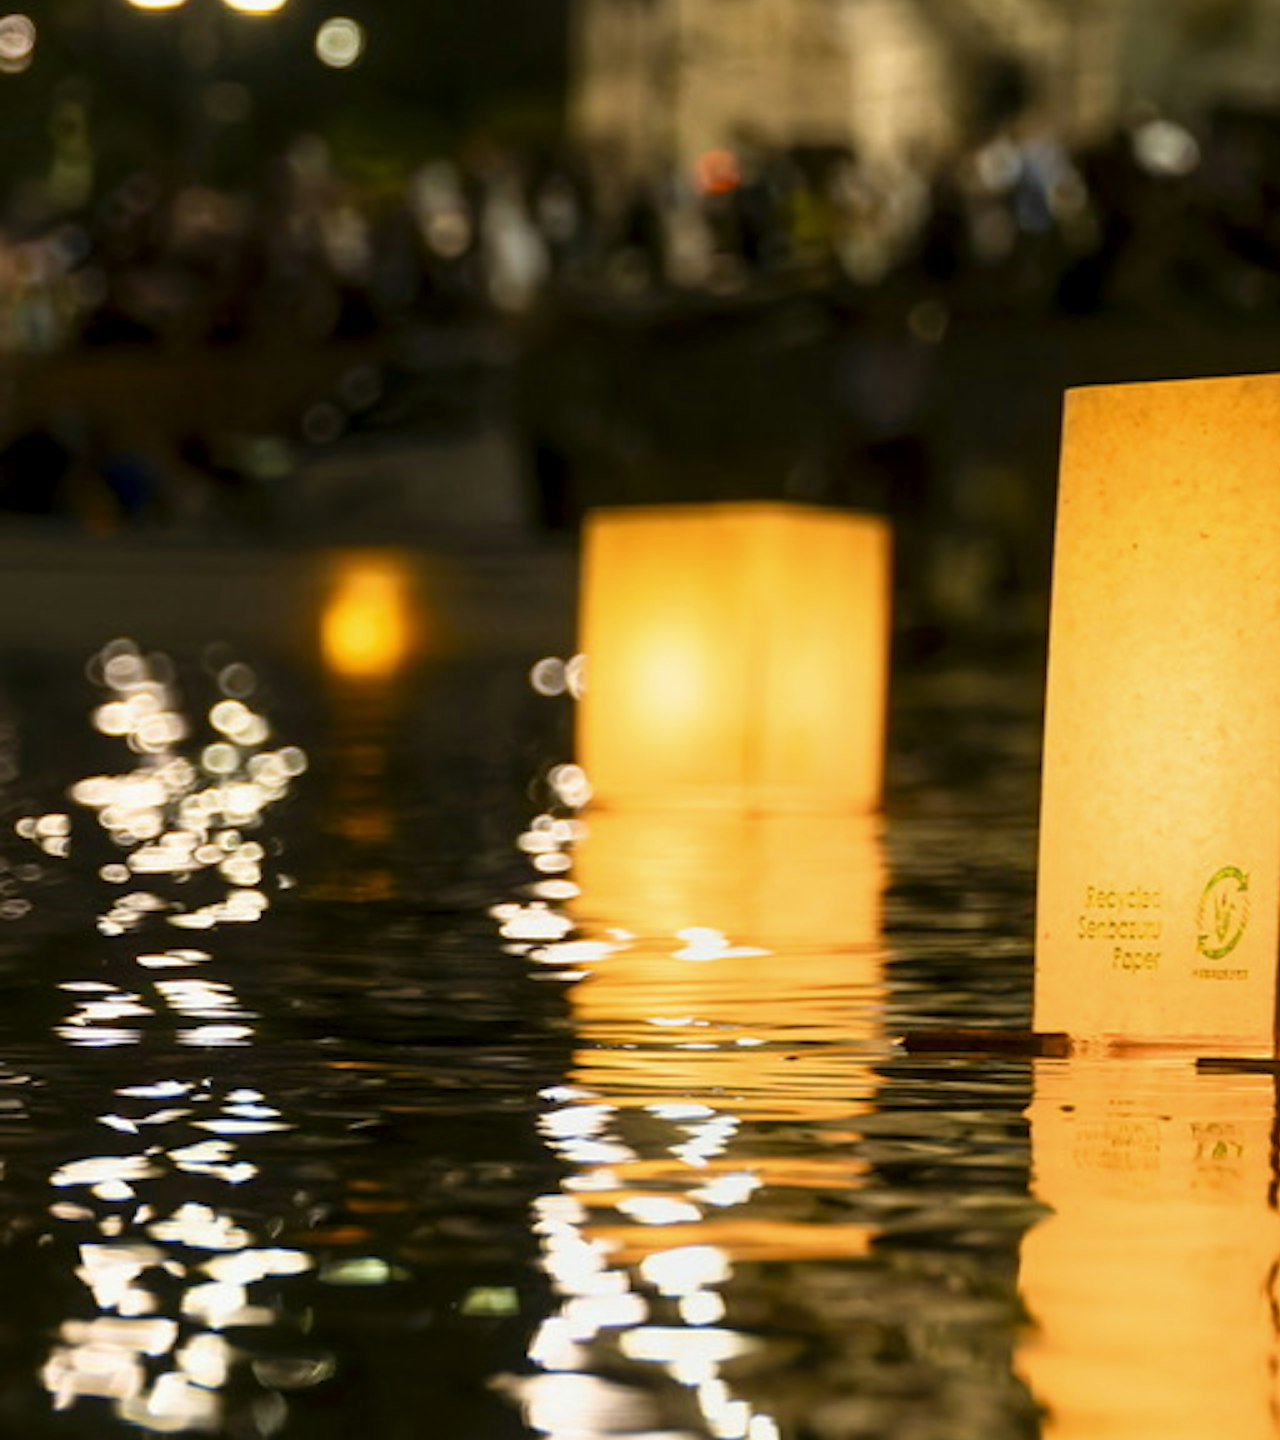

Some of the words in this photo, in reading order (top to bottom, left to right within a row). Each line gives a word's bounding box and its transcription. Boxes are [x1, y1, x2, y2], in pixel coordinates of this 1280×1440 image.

[1085, 884, 1161, 912] Recycled
[1077, 914, 1162, 940] Senbazuru
[1112, 946, 1161, 974] Paper
